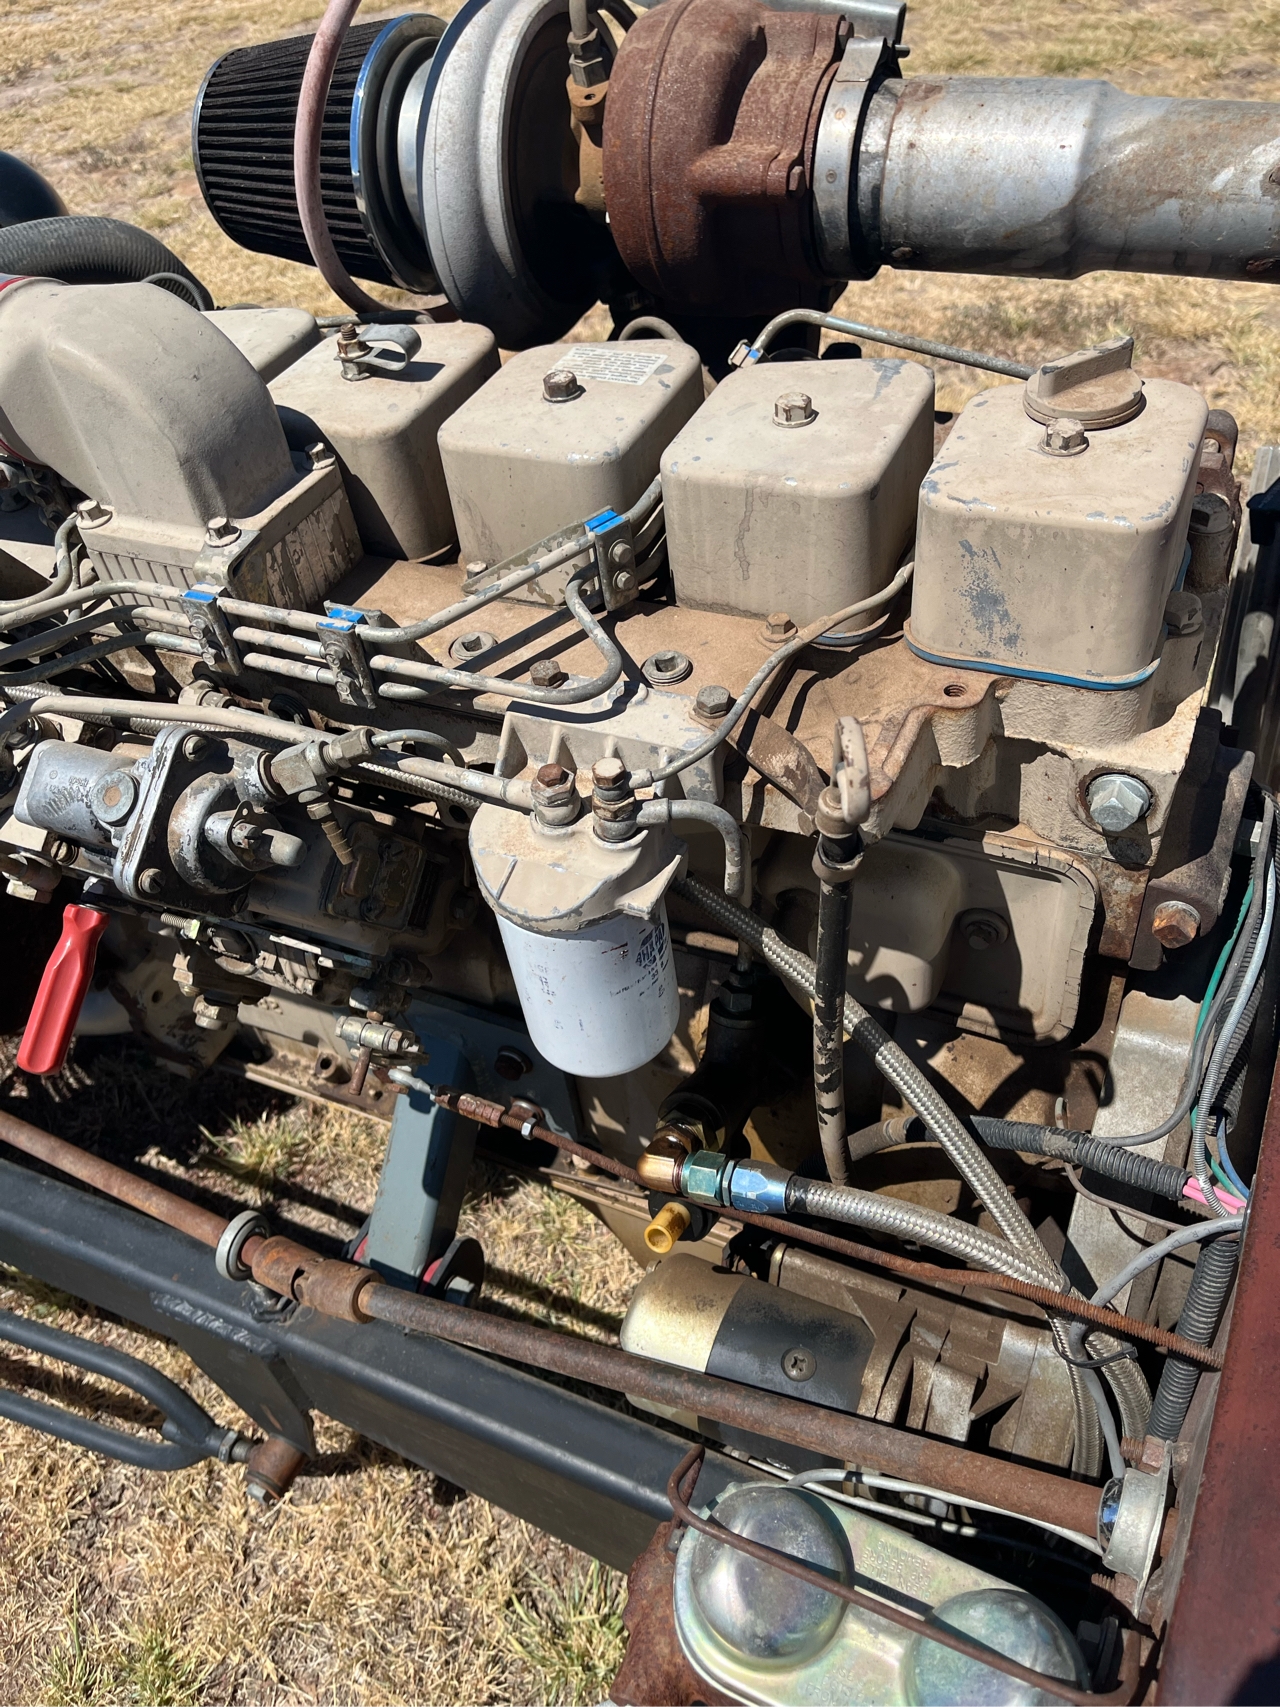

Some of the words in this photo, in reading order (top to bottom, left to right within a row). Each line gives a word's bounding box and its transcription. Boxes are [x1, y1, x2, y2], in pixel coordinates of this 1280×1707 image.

[1147, 1252, 1160, 1262] RR
[861, 1546, 904, 1574] BEFORE
[877, 1539, 929, 1571] REMOVING
[896, 1573, 931, 1600] CLEAN
[910, 1571, 932, 1586] CAP
